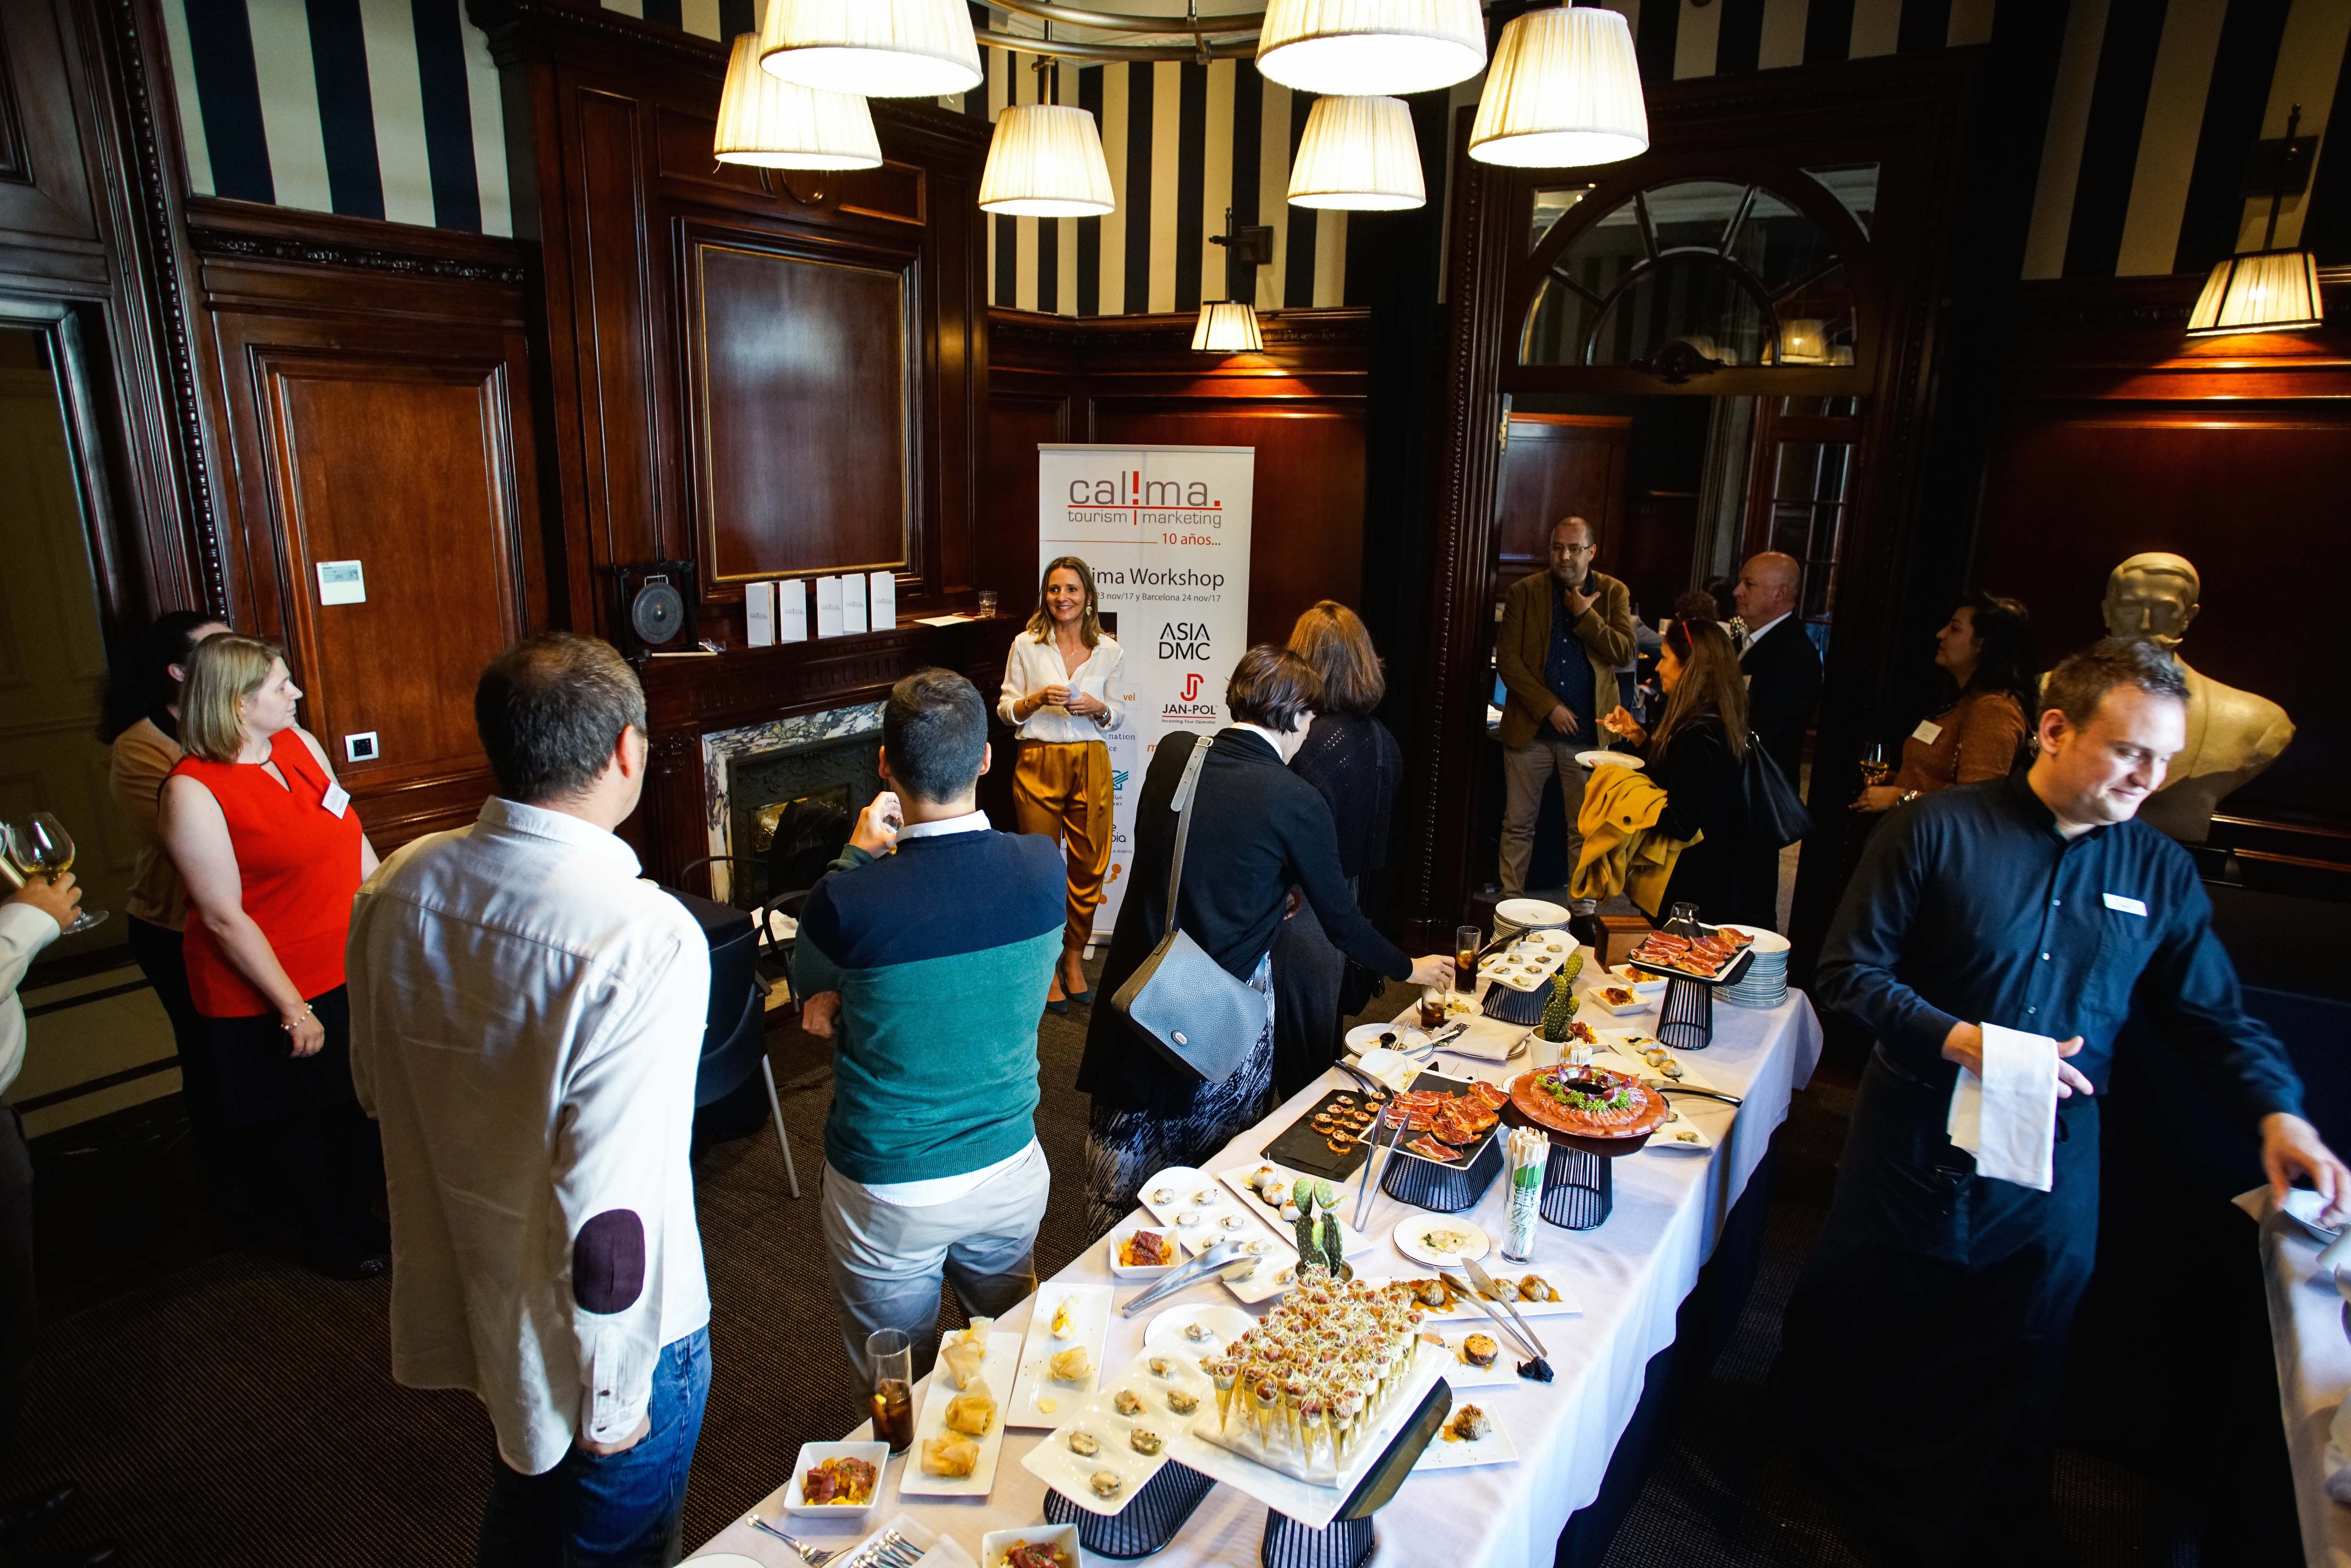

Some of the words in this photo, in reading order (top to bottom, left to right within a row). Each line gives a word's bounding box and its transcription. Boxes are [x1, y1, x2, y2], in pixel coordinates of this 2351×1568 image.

[1068, 509, 1127, 523] tourism
[1143, 511, 1221, 528] marketing
[1163, 533, 1177, 545] 10
[1181, 534, 1221, 546] años...
[1088, 567, 1124, 584] ima
[1129, 568, 1224, 590] Workshop
[1142, 593, 1180, 601] Barcelona
[1159, 622, 1210, 641] ASIA
[1159, 641, 1210, 660] DMC
[1162, 704, 1216, 715] JAN-POL
